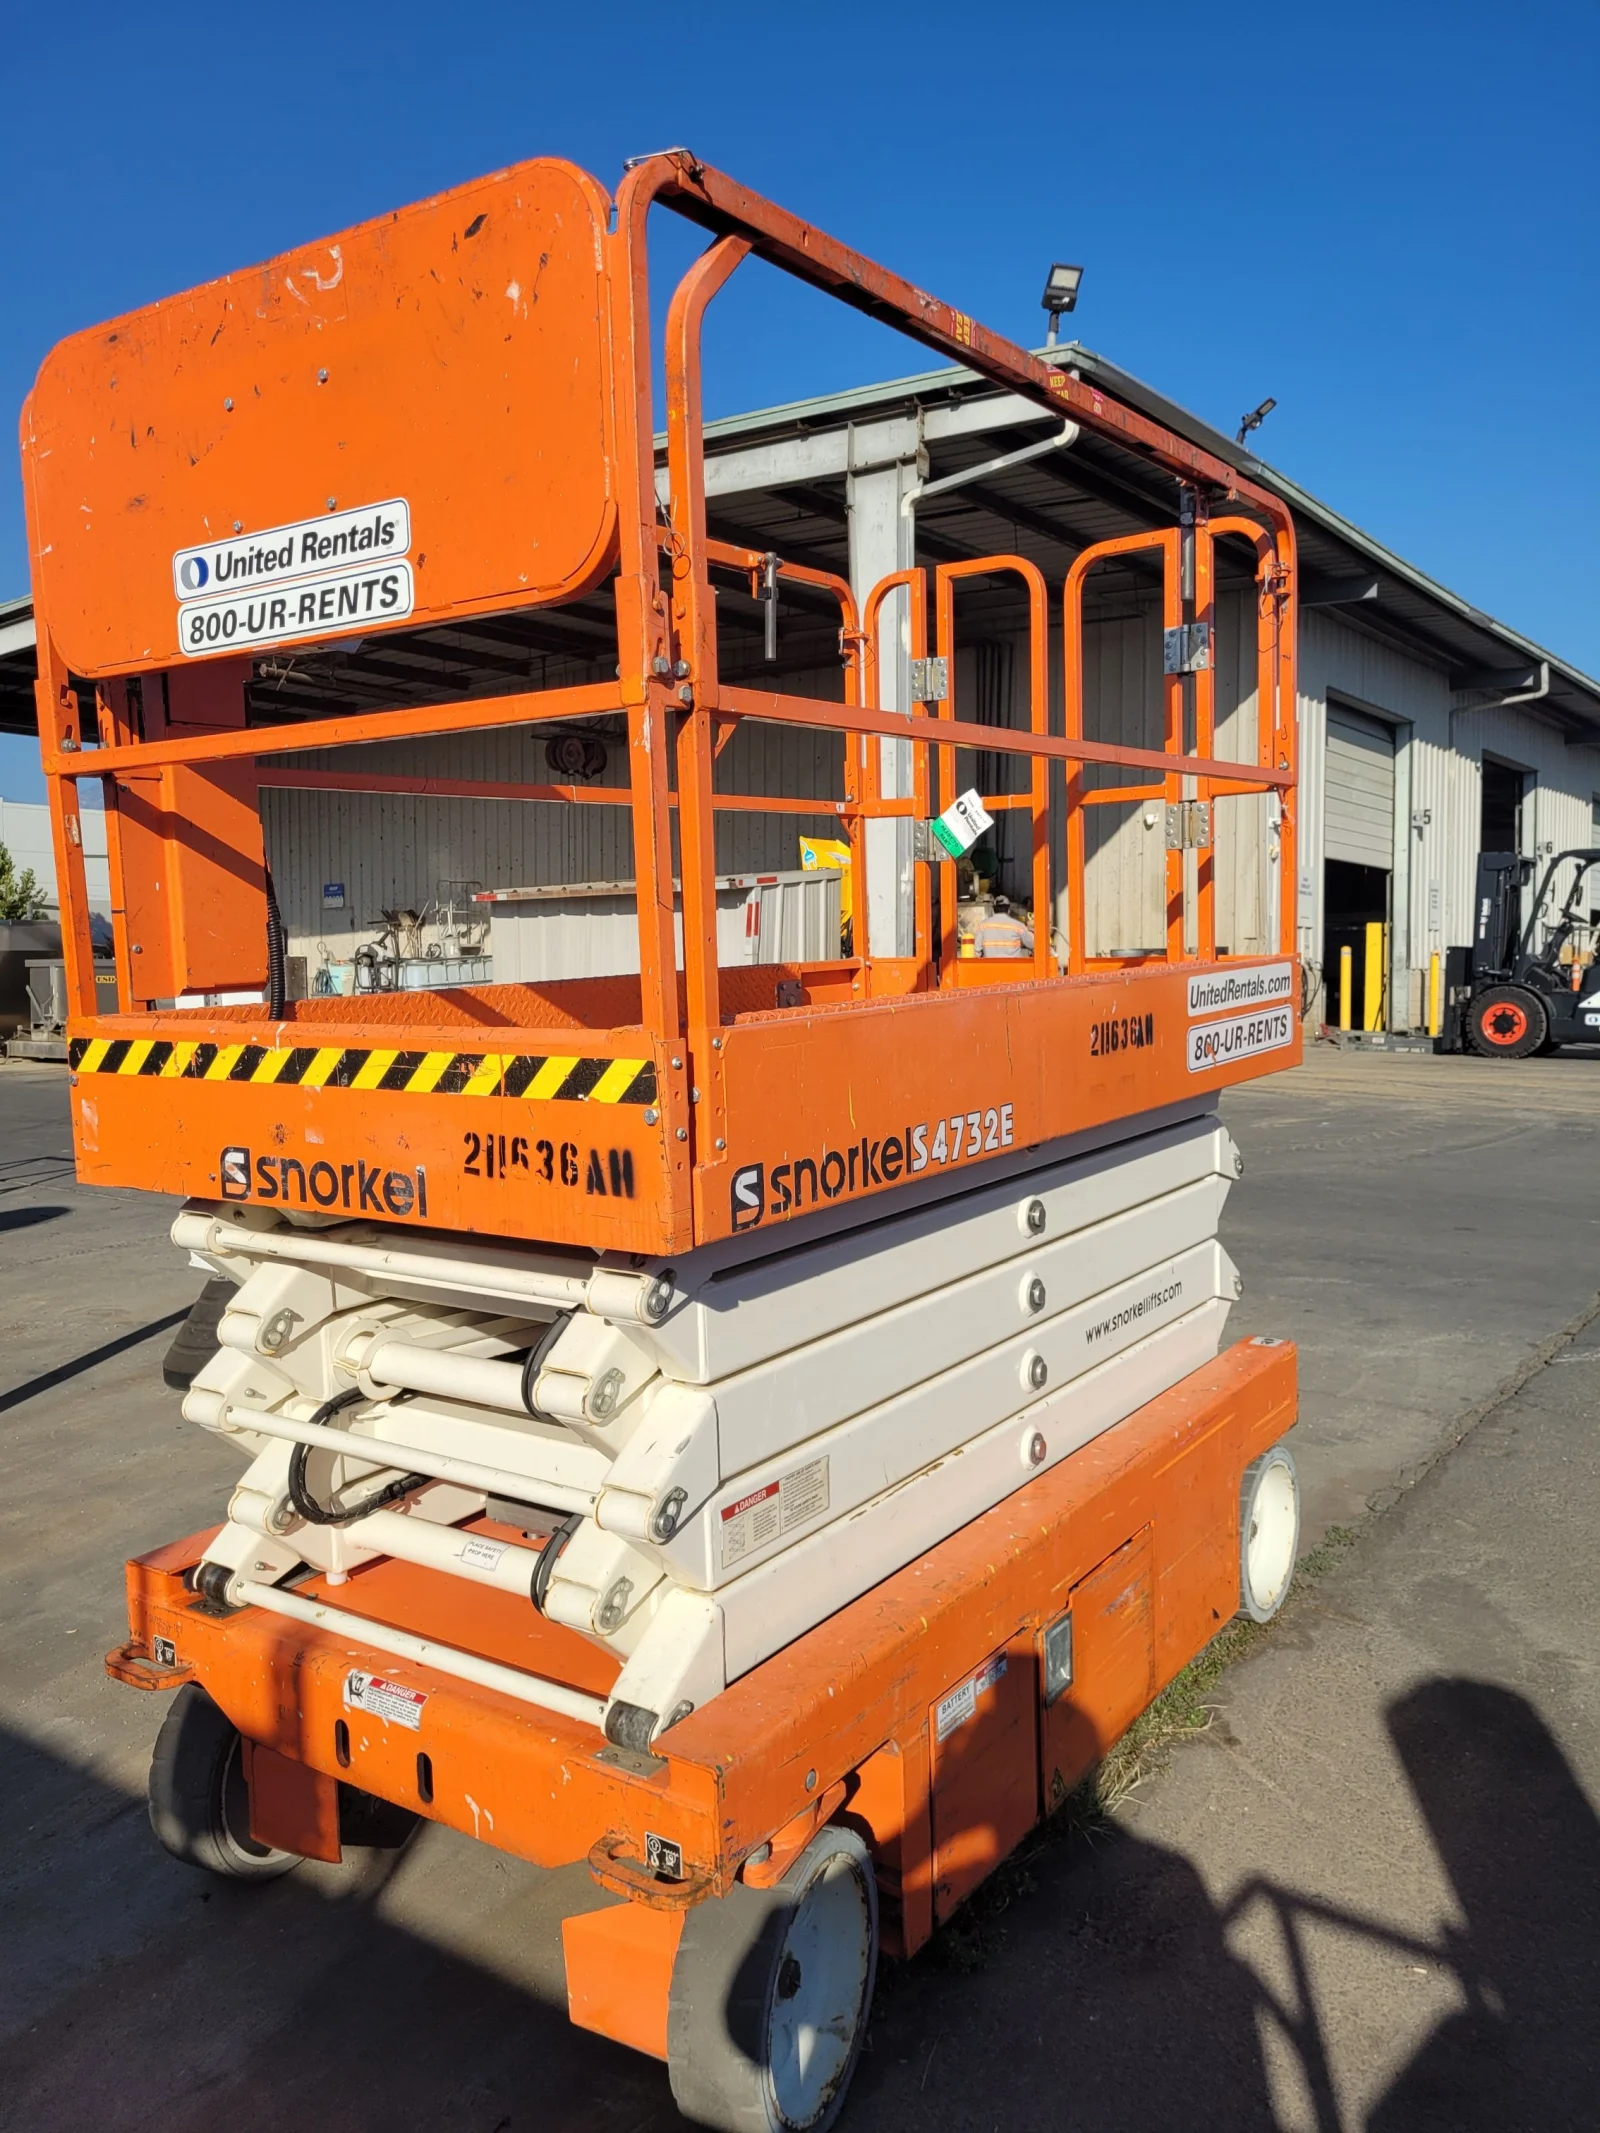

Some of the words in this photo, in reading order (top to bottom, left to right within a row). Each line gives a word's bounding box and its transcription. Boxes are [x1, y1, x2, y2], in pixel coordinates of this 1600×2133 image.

[215, 536, 294, 582] United
[301, 515, 395, 563] Rentals
[189, 574, 400, 645] 800-UR-RENTS
[1423, 809, 1432, 825] 5
[1546, 841, 1553, 854] 6
[1190, 973, 1291, 1009] UnitedRentals.com
[1194, 1014, 1288, 1062] 800-UR-RENTS
[911, 1102, 1014, 1172] S4732E
[255, 1155, 429, 1219] snorkel
[770, 1127, 912, 1215] snorkel
[1085, 1281, 1183, 1345] www.snorkellifts.com
[739, 1489, 767, 1511] DANGER
[386, 1683, 417, 1701] DANGER
[941, 1684, 971, 1715] BATTERY
